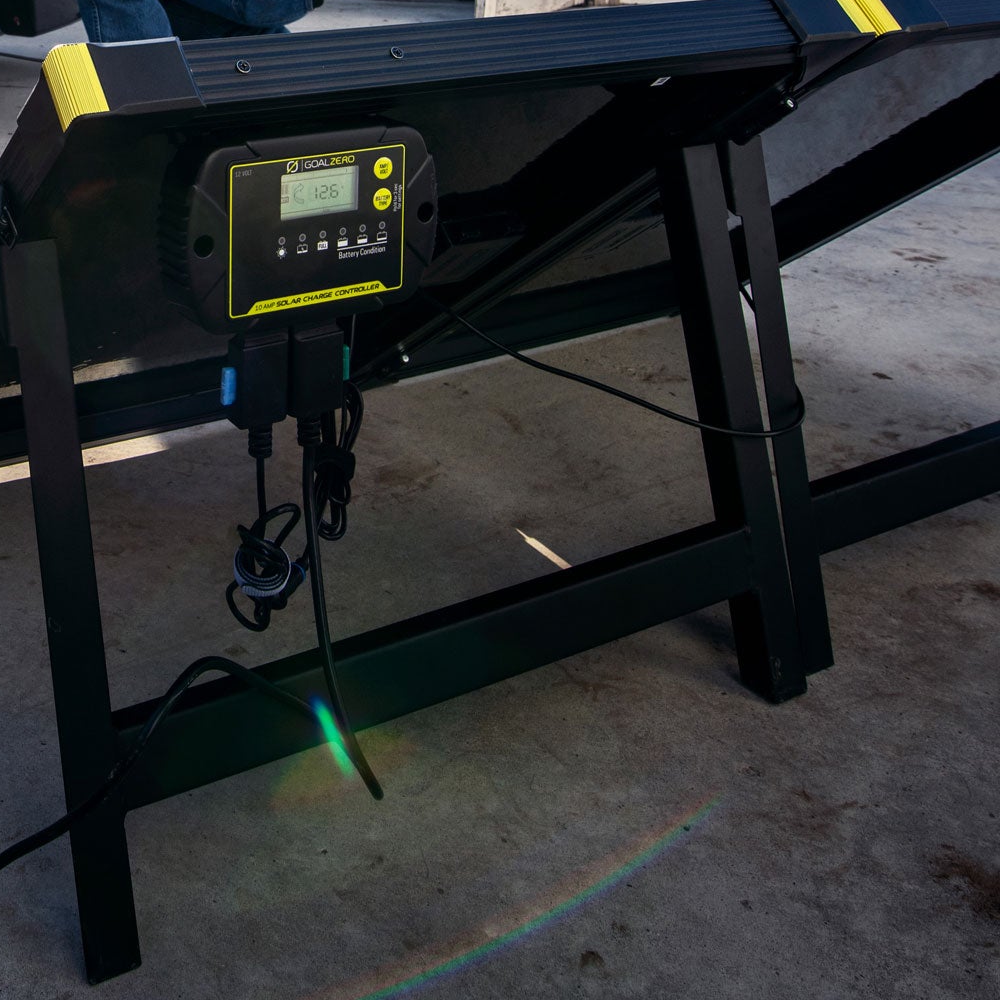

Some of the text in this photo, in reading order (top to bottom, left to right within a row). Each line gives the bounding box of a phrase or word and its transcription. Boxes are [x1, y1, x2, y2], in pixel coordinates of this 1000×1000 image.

[235, 169, 252, 178] 12 VOLT
[314, 184, 338, 200] 12.6
[338, 246, 386, 259] Battery Condition
[276, 297, 302, 308] SOLAR
[302, 292, 333, 302] CHARGE
[334, 283, 380, 297] CONTROLLER
